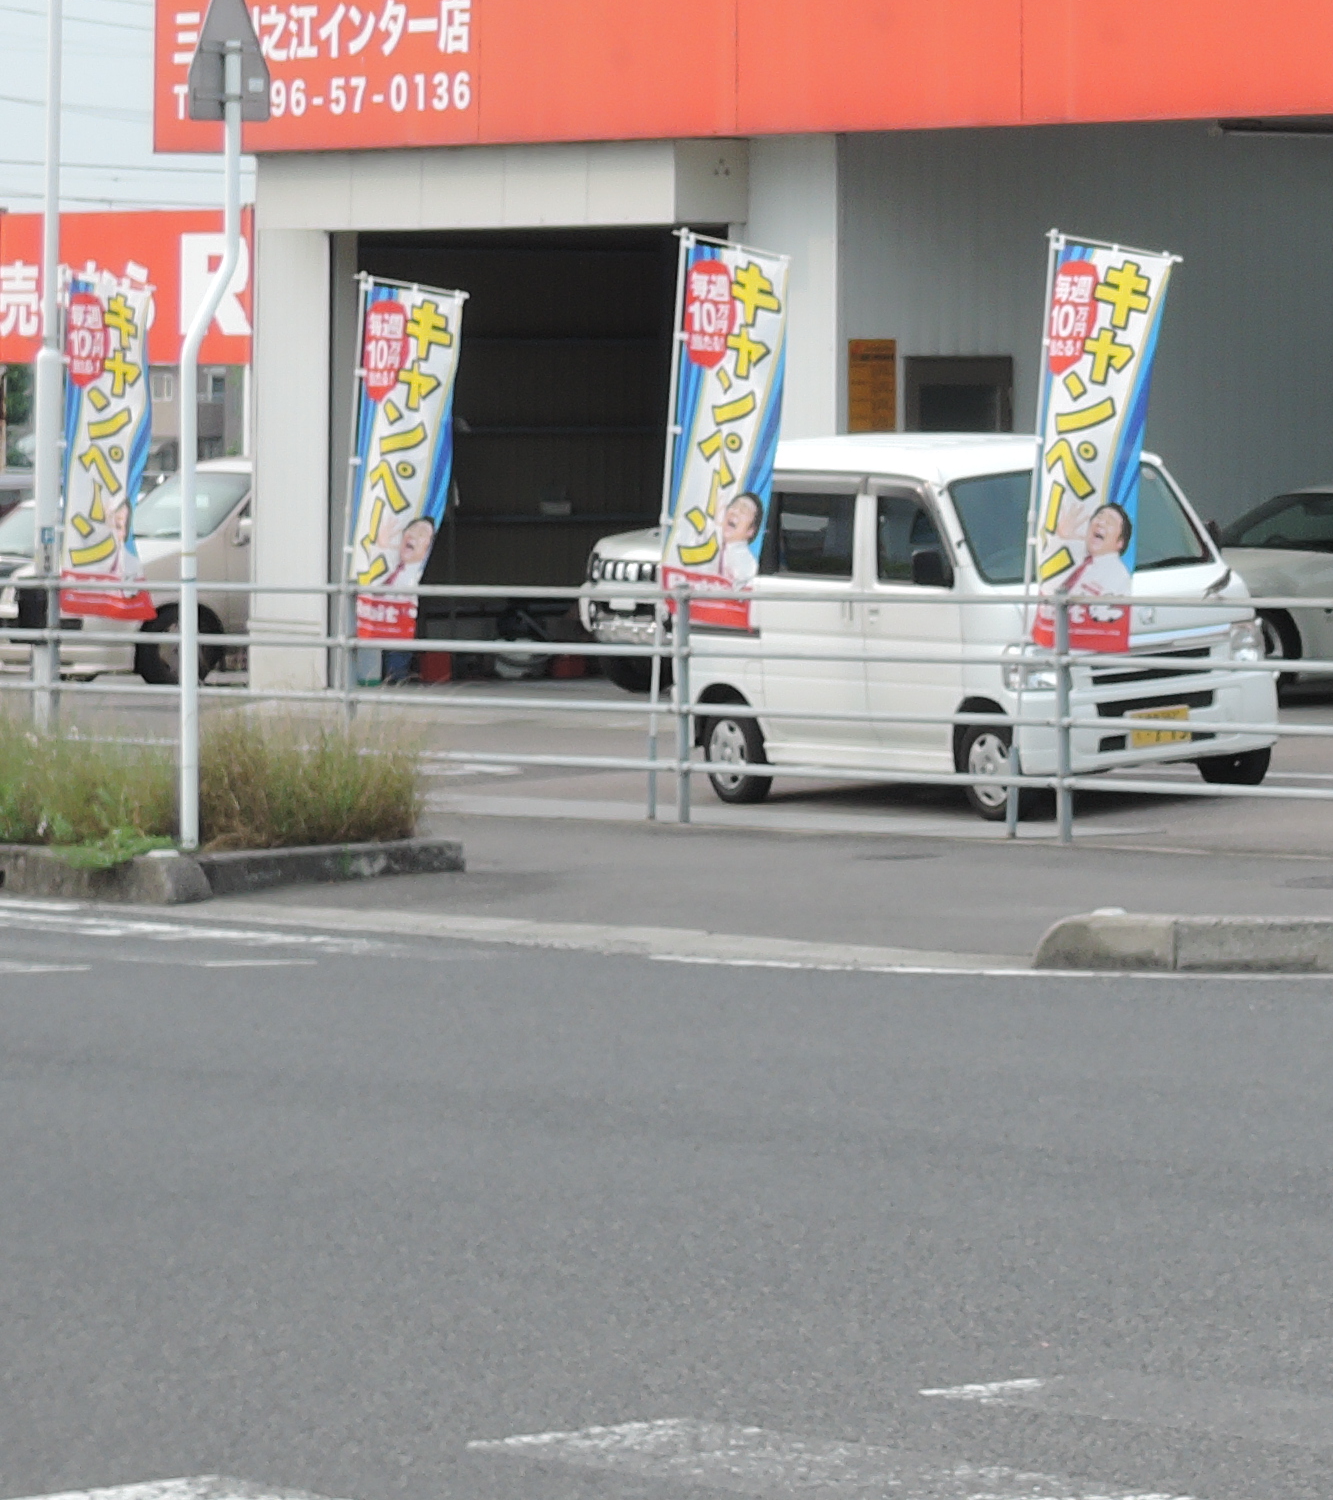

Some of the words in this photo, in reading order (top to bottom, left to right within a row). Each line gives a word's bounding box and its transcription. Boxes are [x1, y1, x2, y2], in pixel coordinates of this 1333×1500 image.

[691, 271, 730, 302] 毎週
[1050, 304, 1090, 338] 10万円
[1055, 273, 1094, 304] 毎週
[68, 293, 142, 567] キャンペーン
[678, 261, 782, 567] キャンペーン
[1036, 260, 1152, 583] キャンペーン
